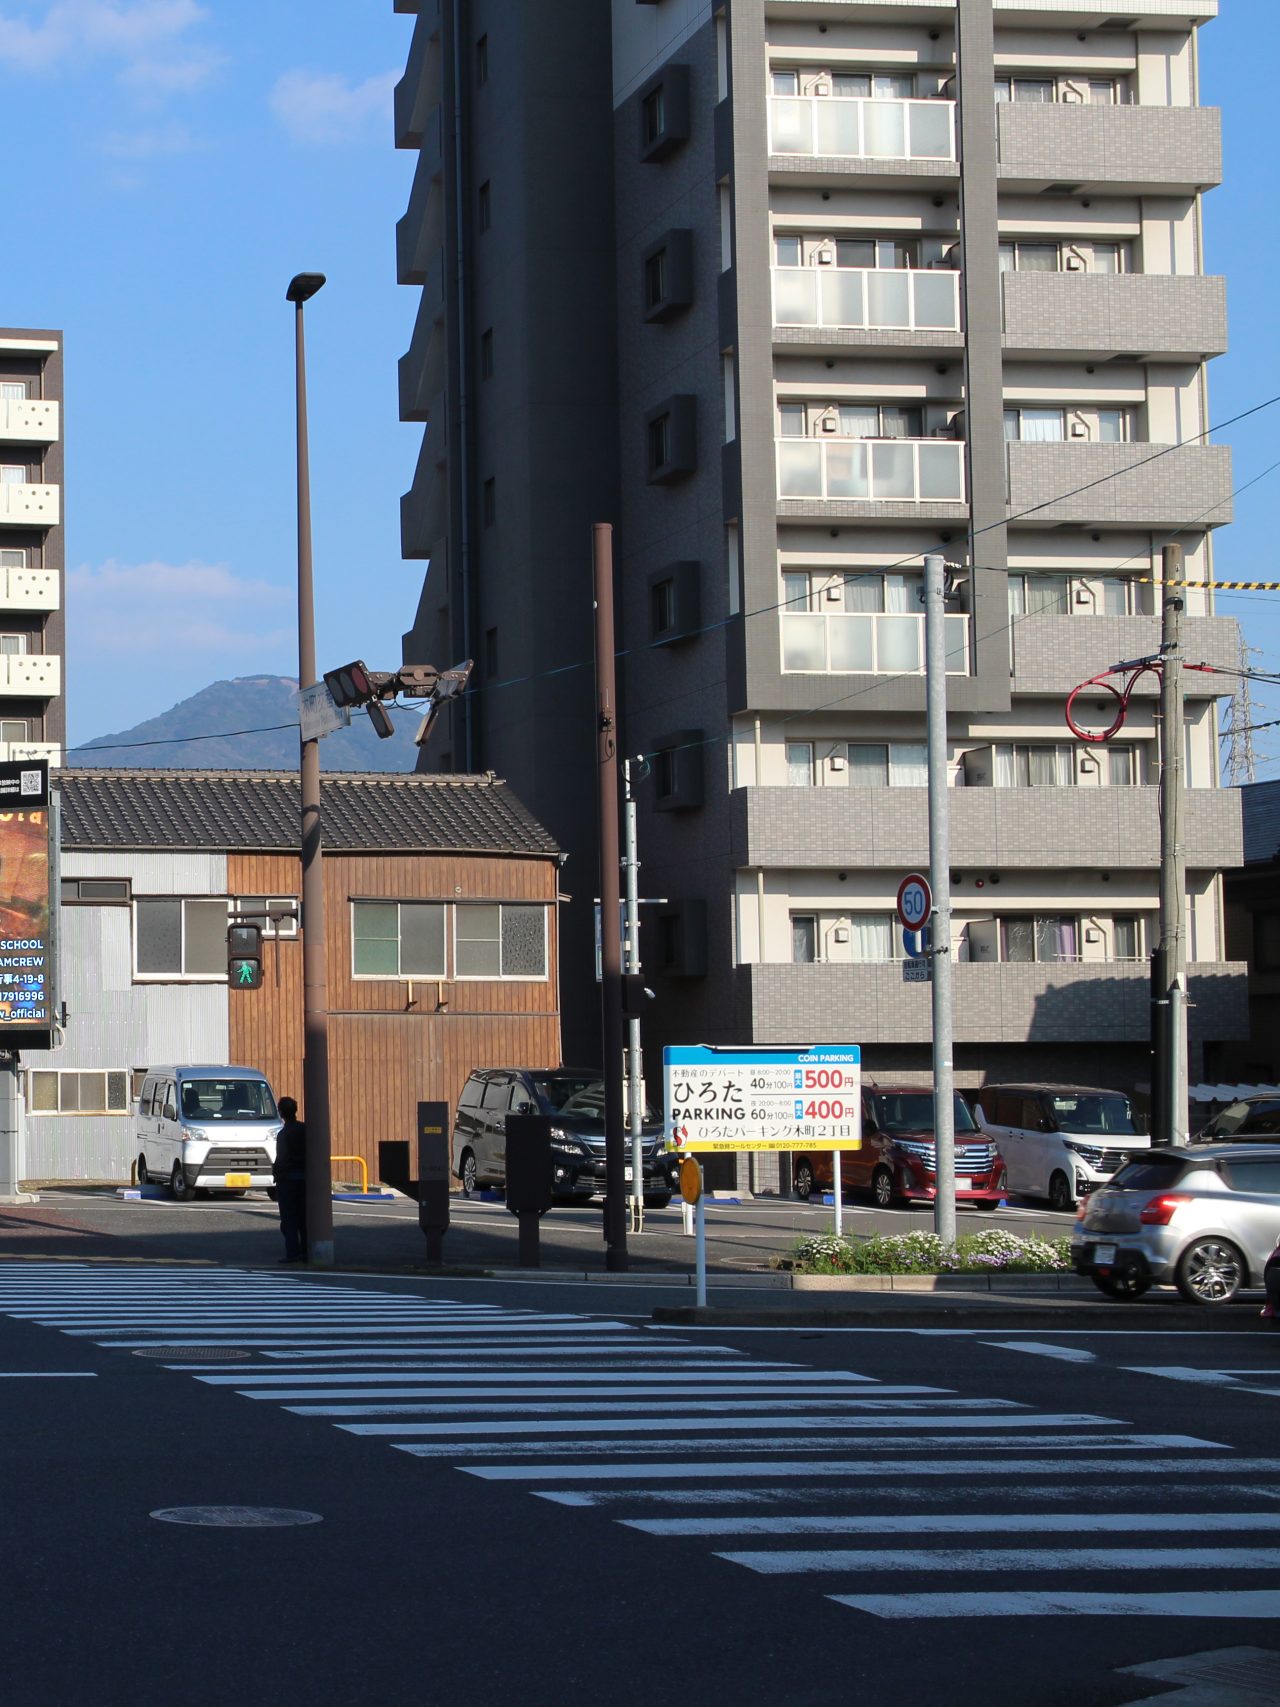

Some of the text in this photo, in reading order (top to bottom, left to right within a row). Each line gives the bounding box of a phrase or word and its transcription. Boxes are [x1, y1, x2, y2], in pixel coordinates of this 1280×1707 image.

[904, 890, 923, 916] 50
[0, 940, 44, 950] SCHOOL
[798, 1054, 854, 1062] COIN PARKING
[672, 1068, 744, 1078] 不動産のデパート
[673, 1080, 743, 1104] ひろた
[672, 1108, 746, 1120] PARKING
